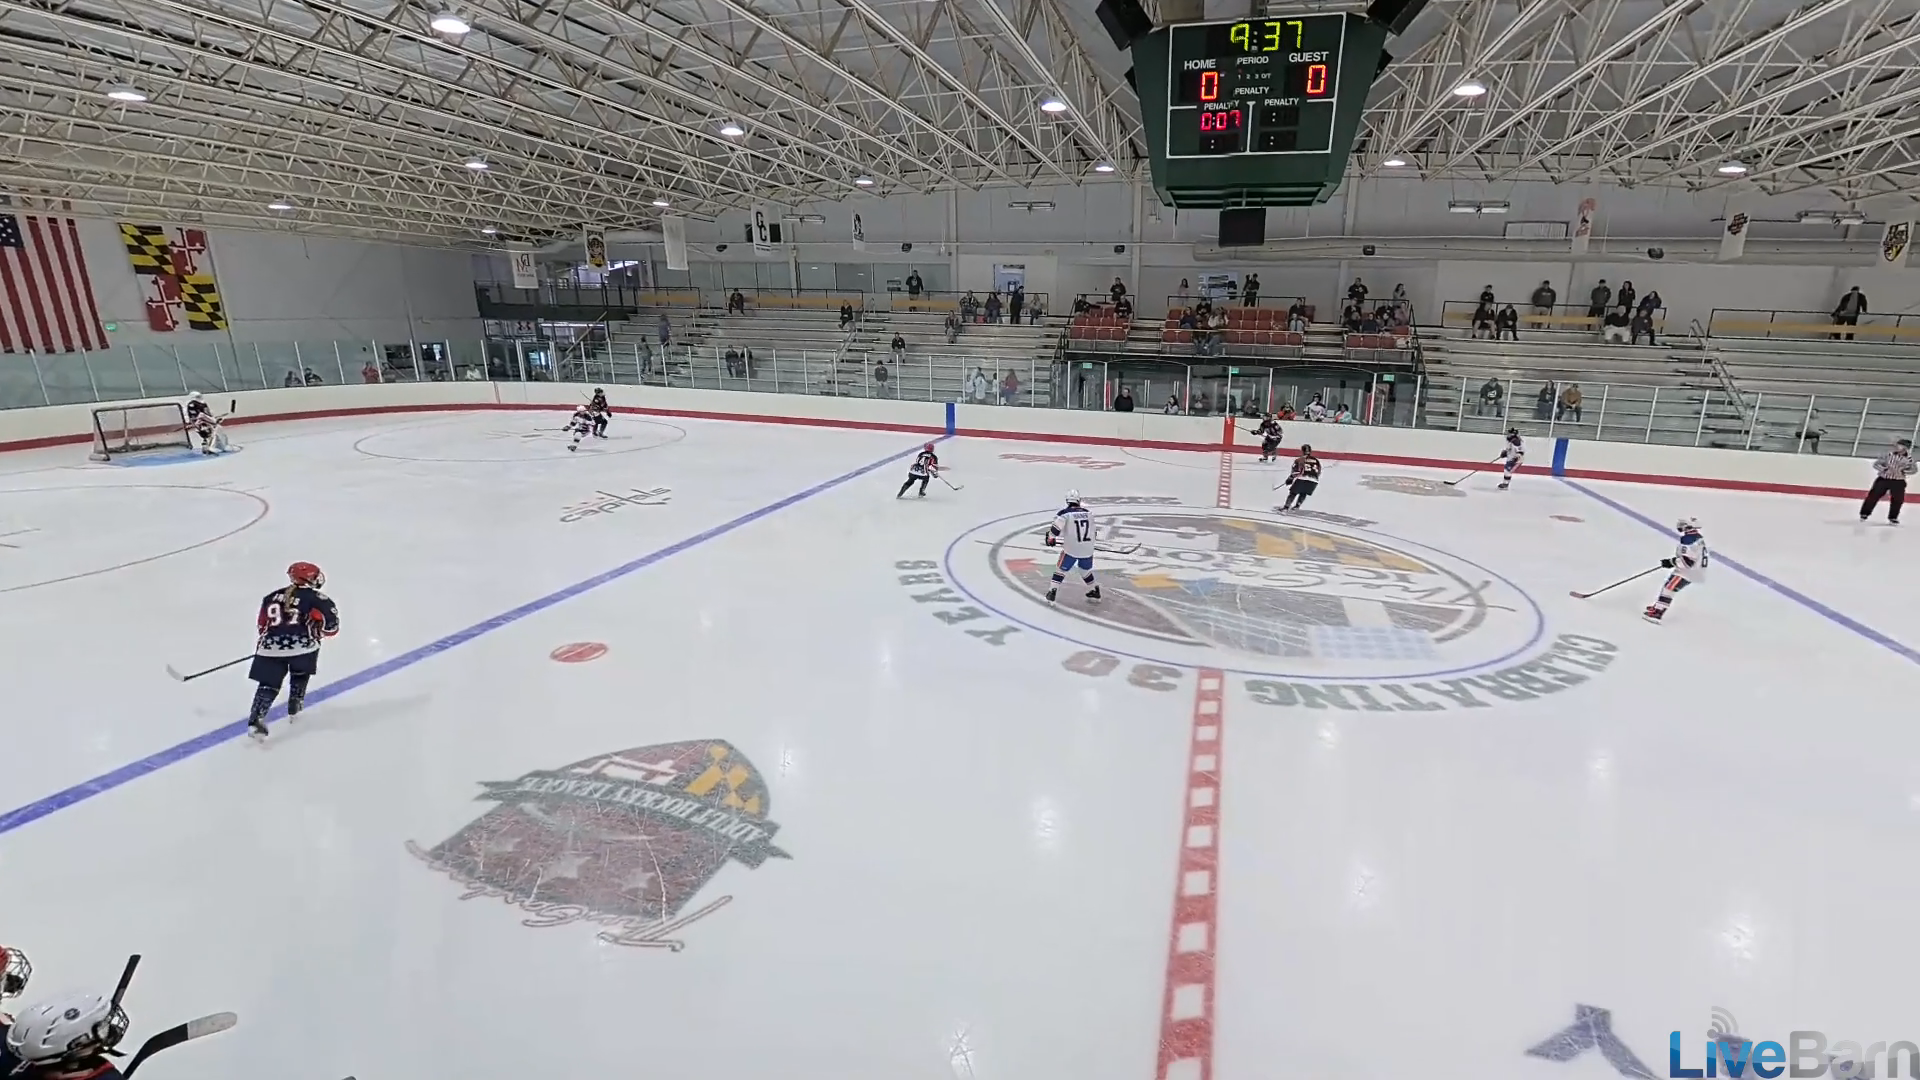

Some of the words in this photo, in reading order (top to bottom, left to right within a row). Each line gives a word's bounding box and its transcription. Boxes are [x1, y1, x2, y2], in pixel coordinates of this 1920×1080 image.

[1230, 20, 1303, 51] 9:37
[1184, 58, 1217, 70] HOME
[1236, 55, 1270, 65] PERIOD
[1288, 51, 1329, 63] GUEST
[1201, 71, 1218, 100] 0
[1234, 86, 1270, 95] PENALTY
[1307, 64, 1327, 94] 0
[1204, 100, 1240, 111] PENALTY
[1264, 98, 1299, 107] PENALTY
[1201, 110, 1241, 131] 0:07
[1074, 519, 1092, 543] 12
[1293, 561, 1419, 585] ICE
[895, 559, 1025, 647] YEARS
[1061, 649, 1184, 693] 30
[1244, 633, 1619, 712] CELEBRATING
[520, 775, 611, 801] LEAGUE
[606, 785, 699, 819] HOCKEY
[689, 805, 768, 843] ADULT
